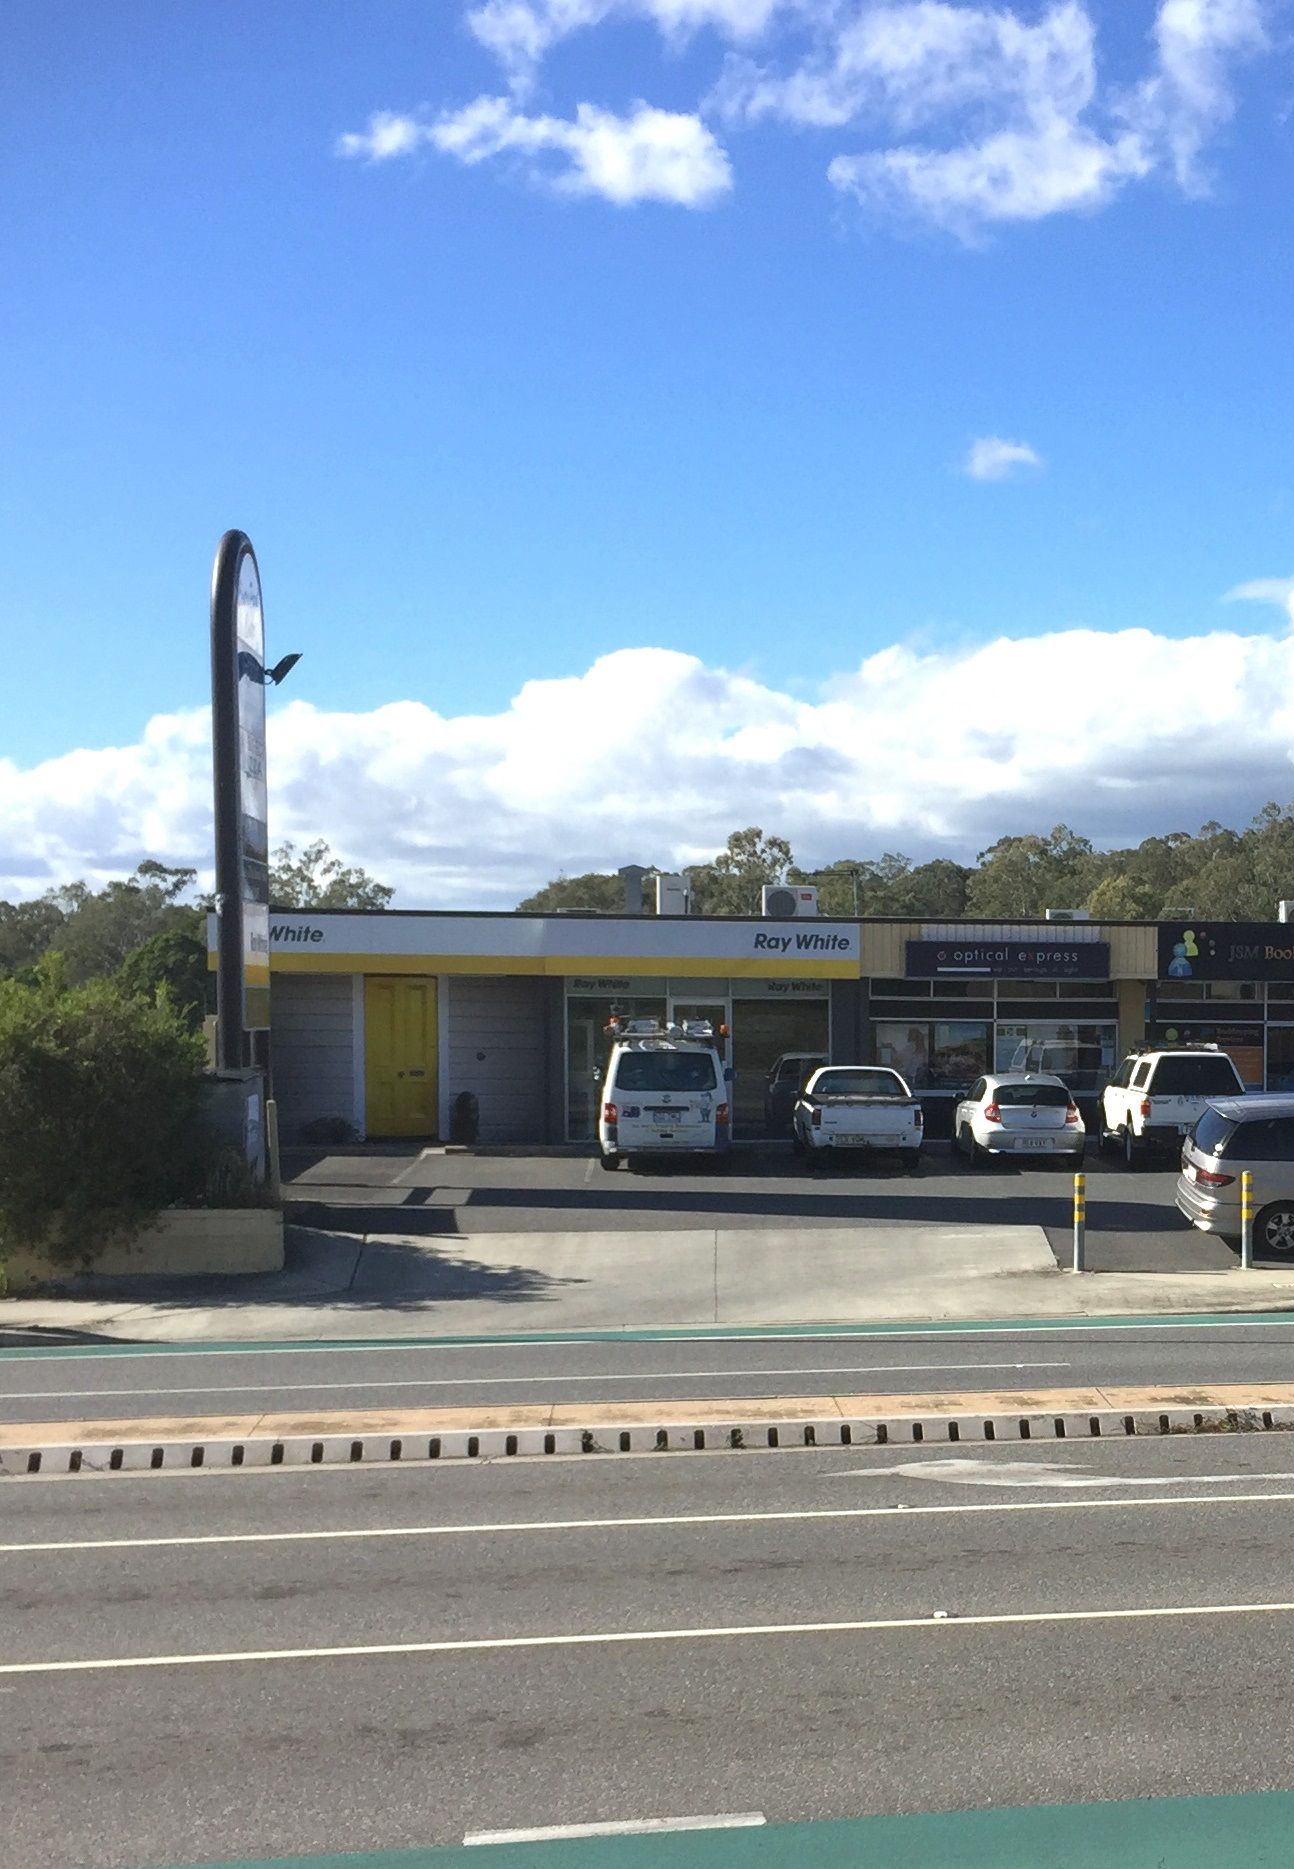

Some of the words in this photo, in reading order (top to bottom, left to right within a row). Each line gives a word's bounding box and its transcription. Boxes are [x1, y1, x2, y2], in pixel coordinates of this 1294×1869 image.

[269, 925, 324, 942] White
[754, 933, 791, 952] Ray
[796, 934, 850, 950] White
[953, 947, 1009, 964] optical
[1018, 951, 1078, 964] express
[792, 981, 823, 992] White
